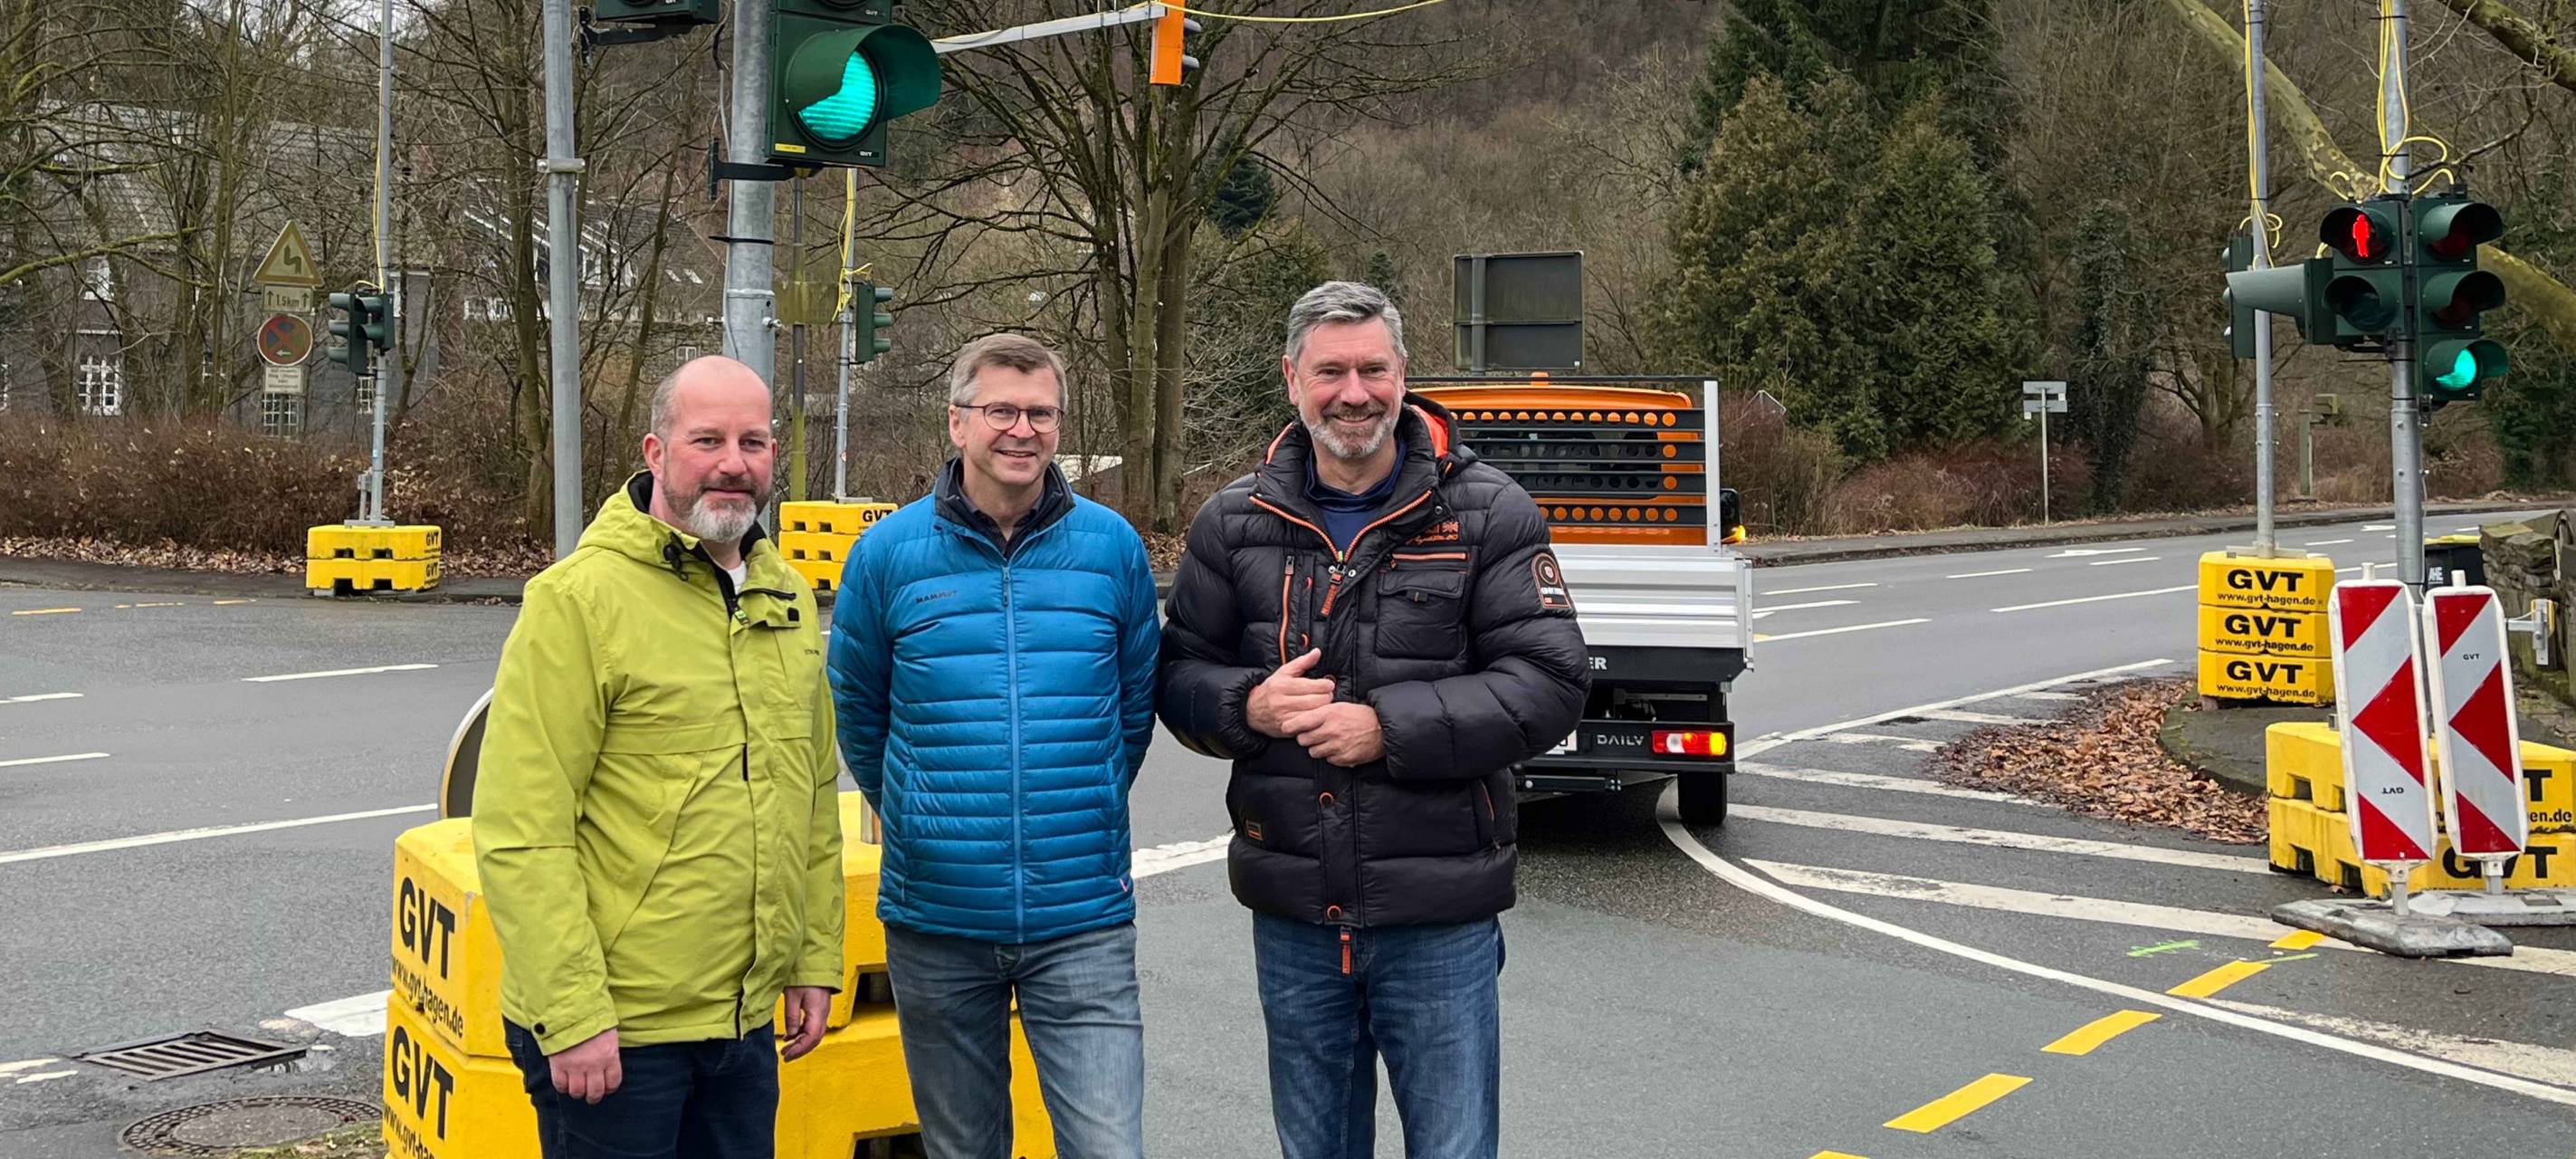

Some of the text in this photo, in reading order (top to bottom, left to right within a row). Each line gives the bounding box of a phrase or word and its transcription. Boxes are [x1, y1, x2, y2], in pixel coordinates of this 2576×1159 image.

[425, 532, 439, 546] GVT
[425, 562, 438, 578] GVT
[2228, 569, 2304, 592] GVT
[2218, 593, 2316, 606] www.gvt-hagen.de
[2225, 614, 2301, 637] GVT
[2216, 638, 2314, 651] www.gvt-hagen.de
[2227, 660, 2303, 684] GVT
[2217, 685, 2315, 697] www.gvt-hagen.de
[1597, 734, 1644, 746] DAILY
[399, 876, 455, 981] GVT
[392, 1025, 453, 1141] GVT
